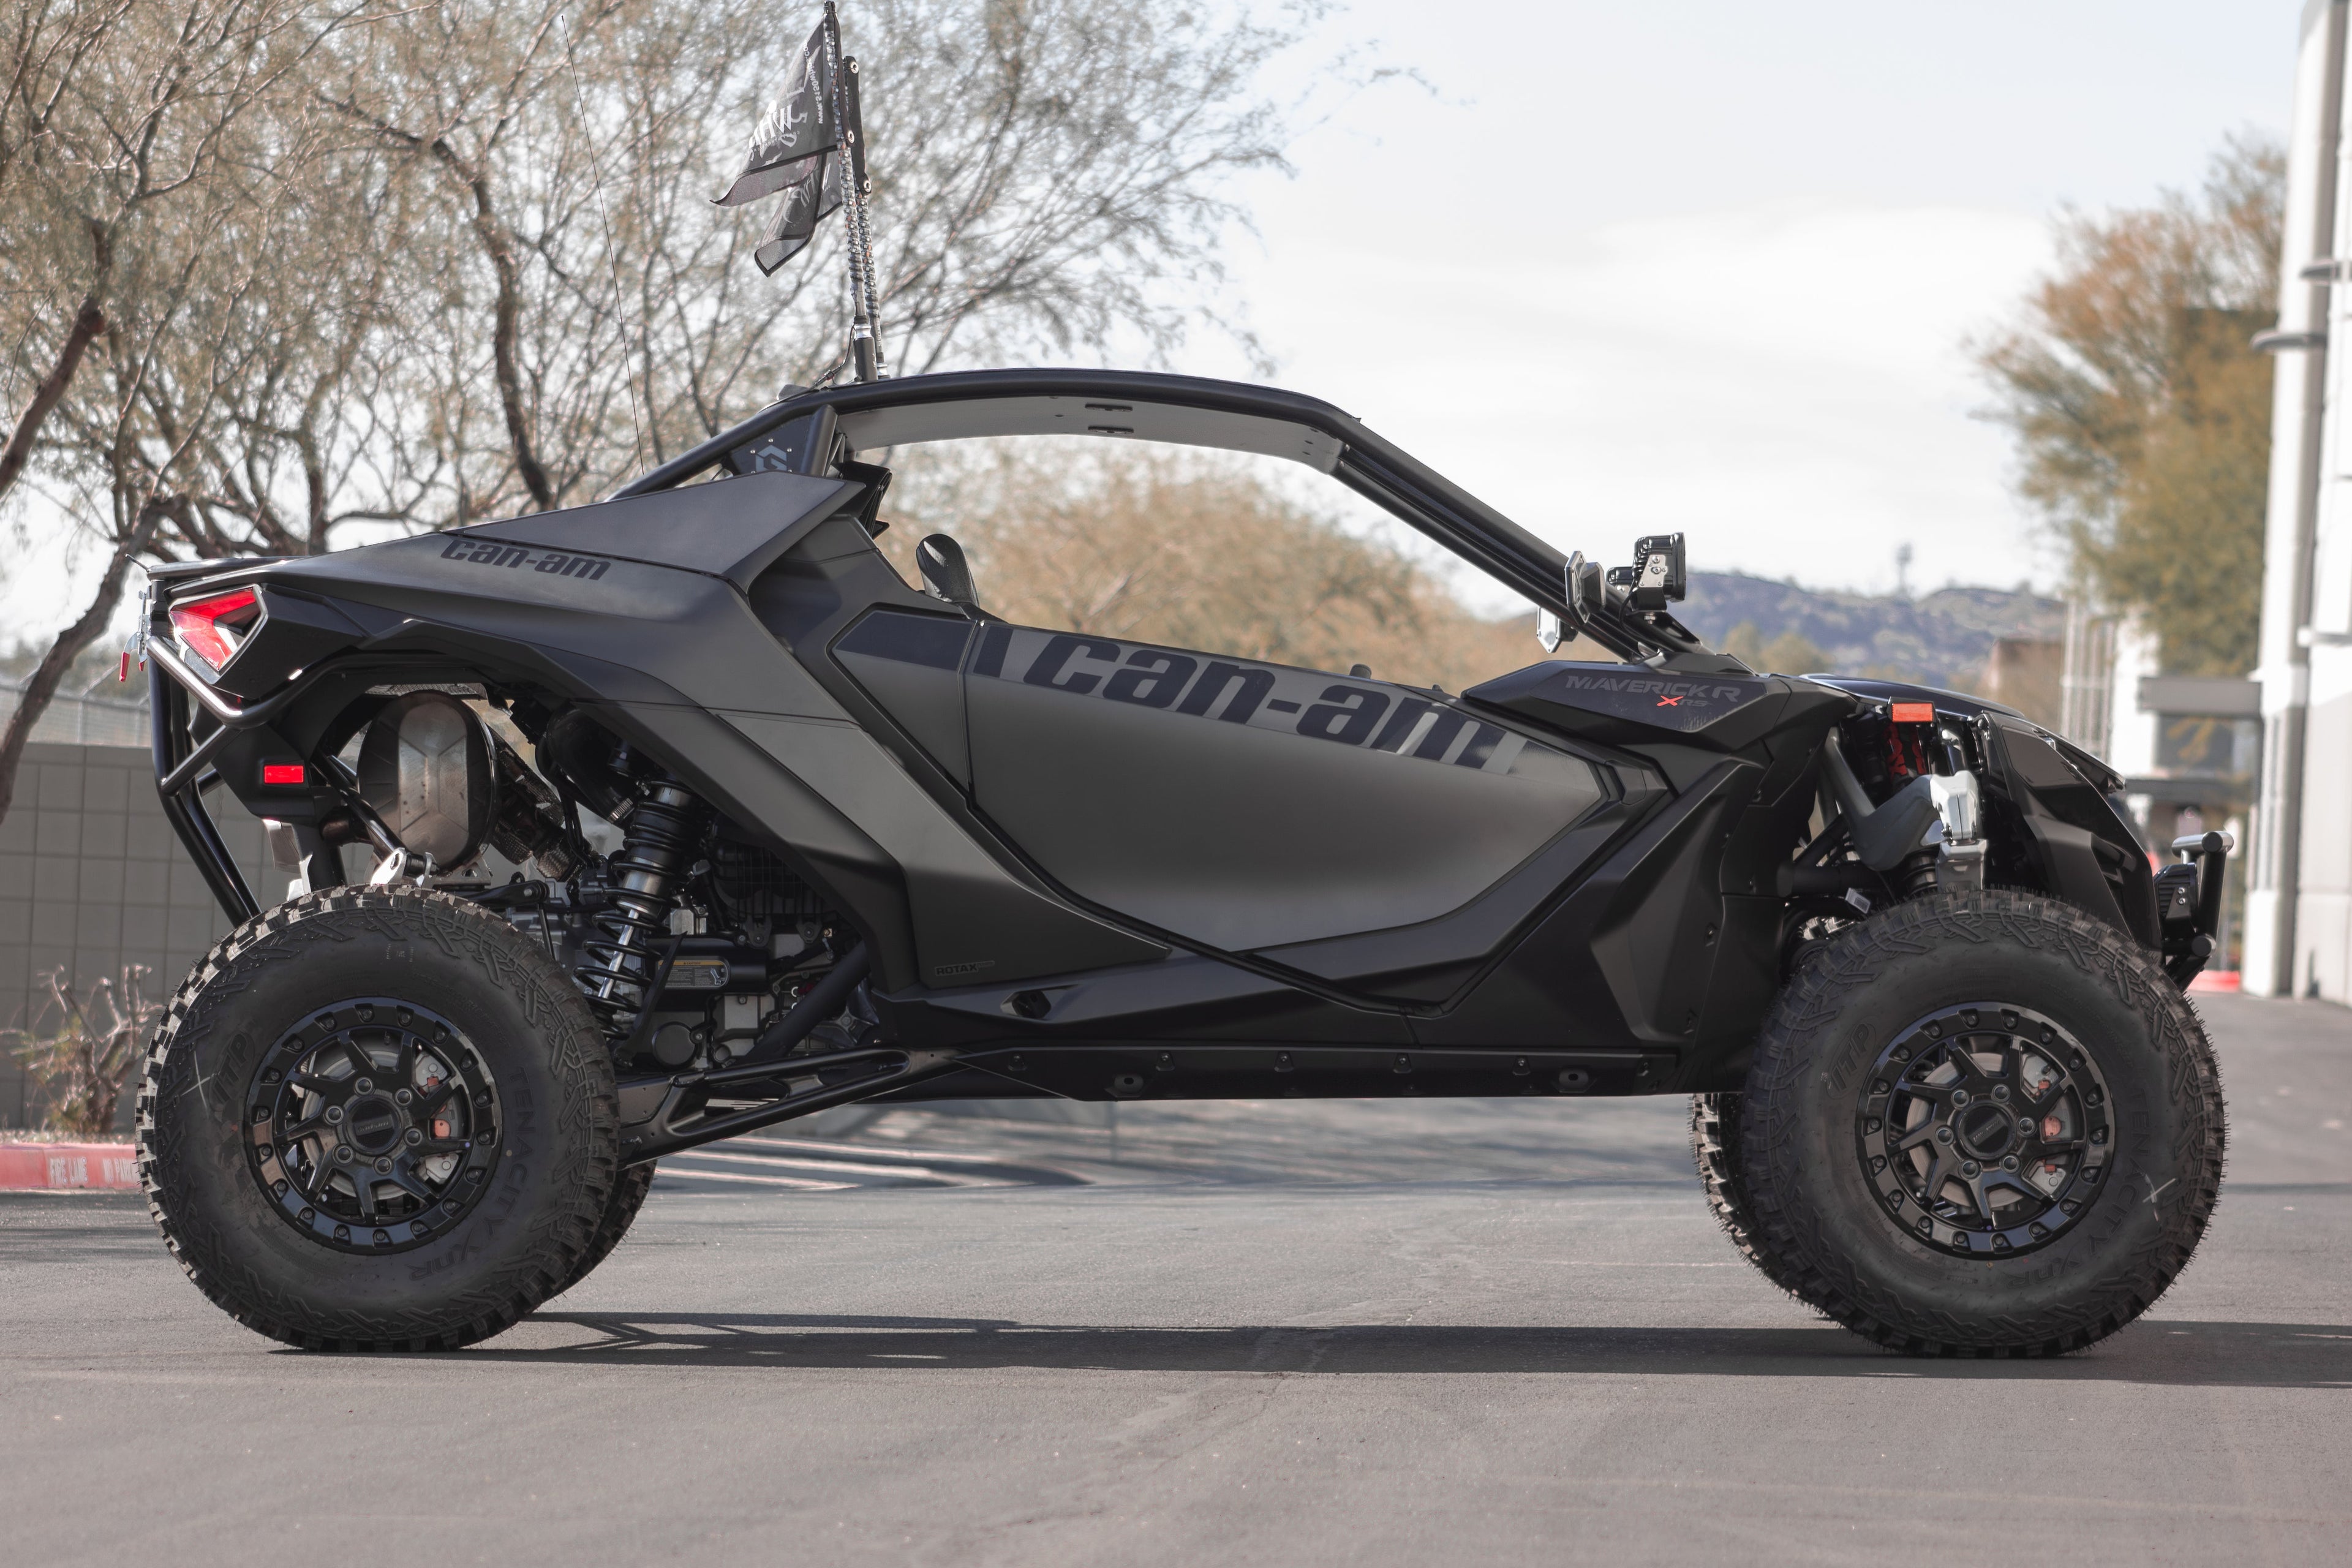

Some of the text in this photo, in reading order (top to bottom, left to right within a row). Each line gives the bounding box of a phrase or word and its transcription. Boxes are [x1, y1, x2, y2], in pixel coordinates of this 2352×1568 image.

[440, 539, 611, 580] can-am
[1023, 634, 1507, 769] can-am
[1565, 676, 1741, 703] MAVERICK R
[936, 963, 978, 975] ROTAX
[213, 1033, 248, 1105] ITP
[1831, 1023, 1869, 1091] ITP
[484, 1066, 538, 1239] TENACITY
[2087, 1087, 2152, 1256] TENACITY
